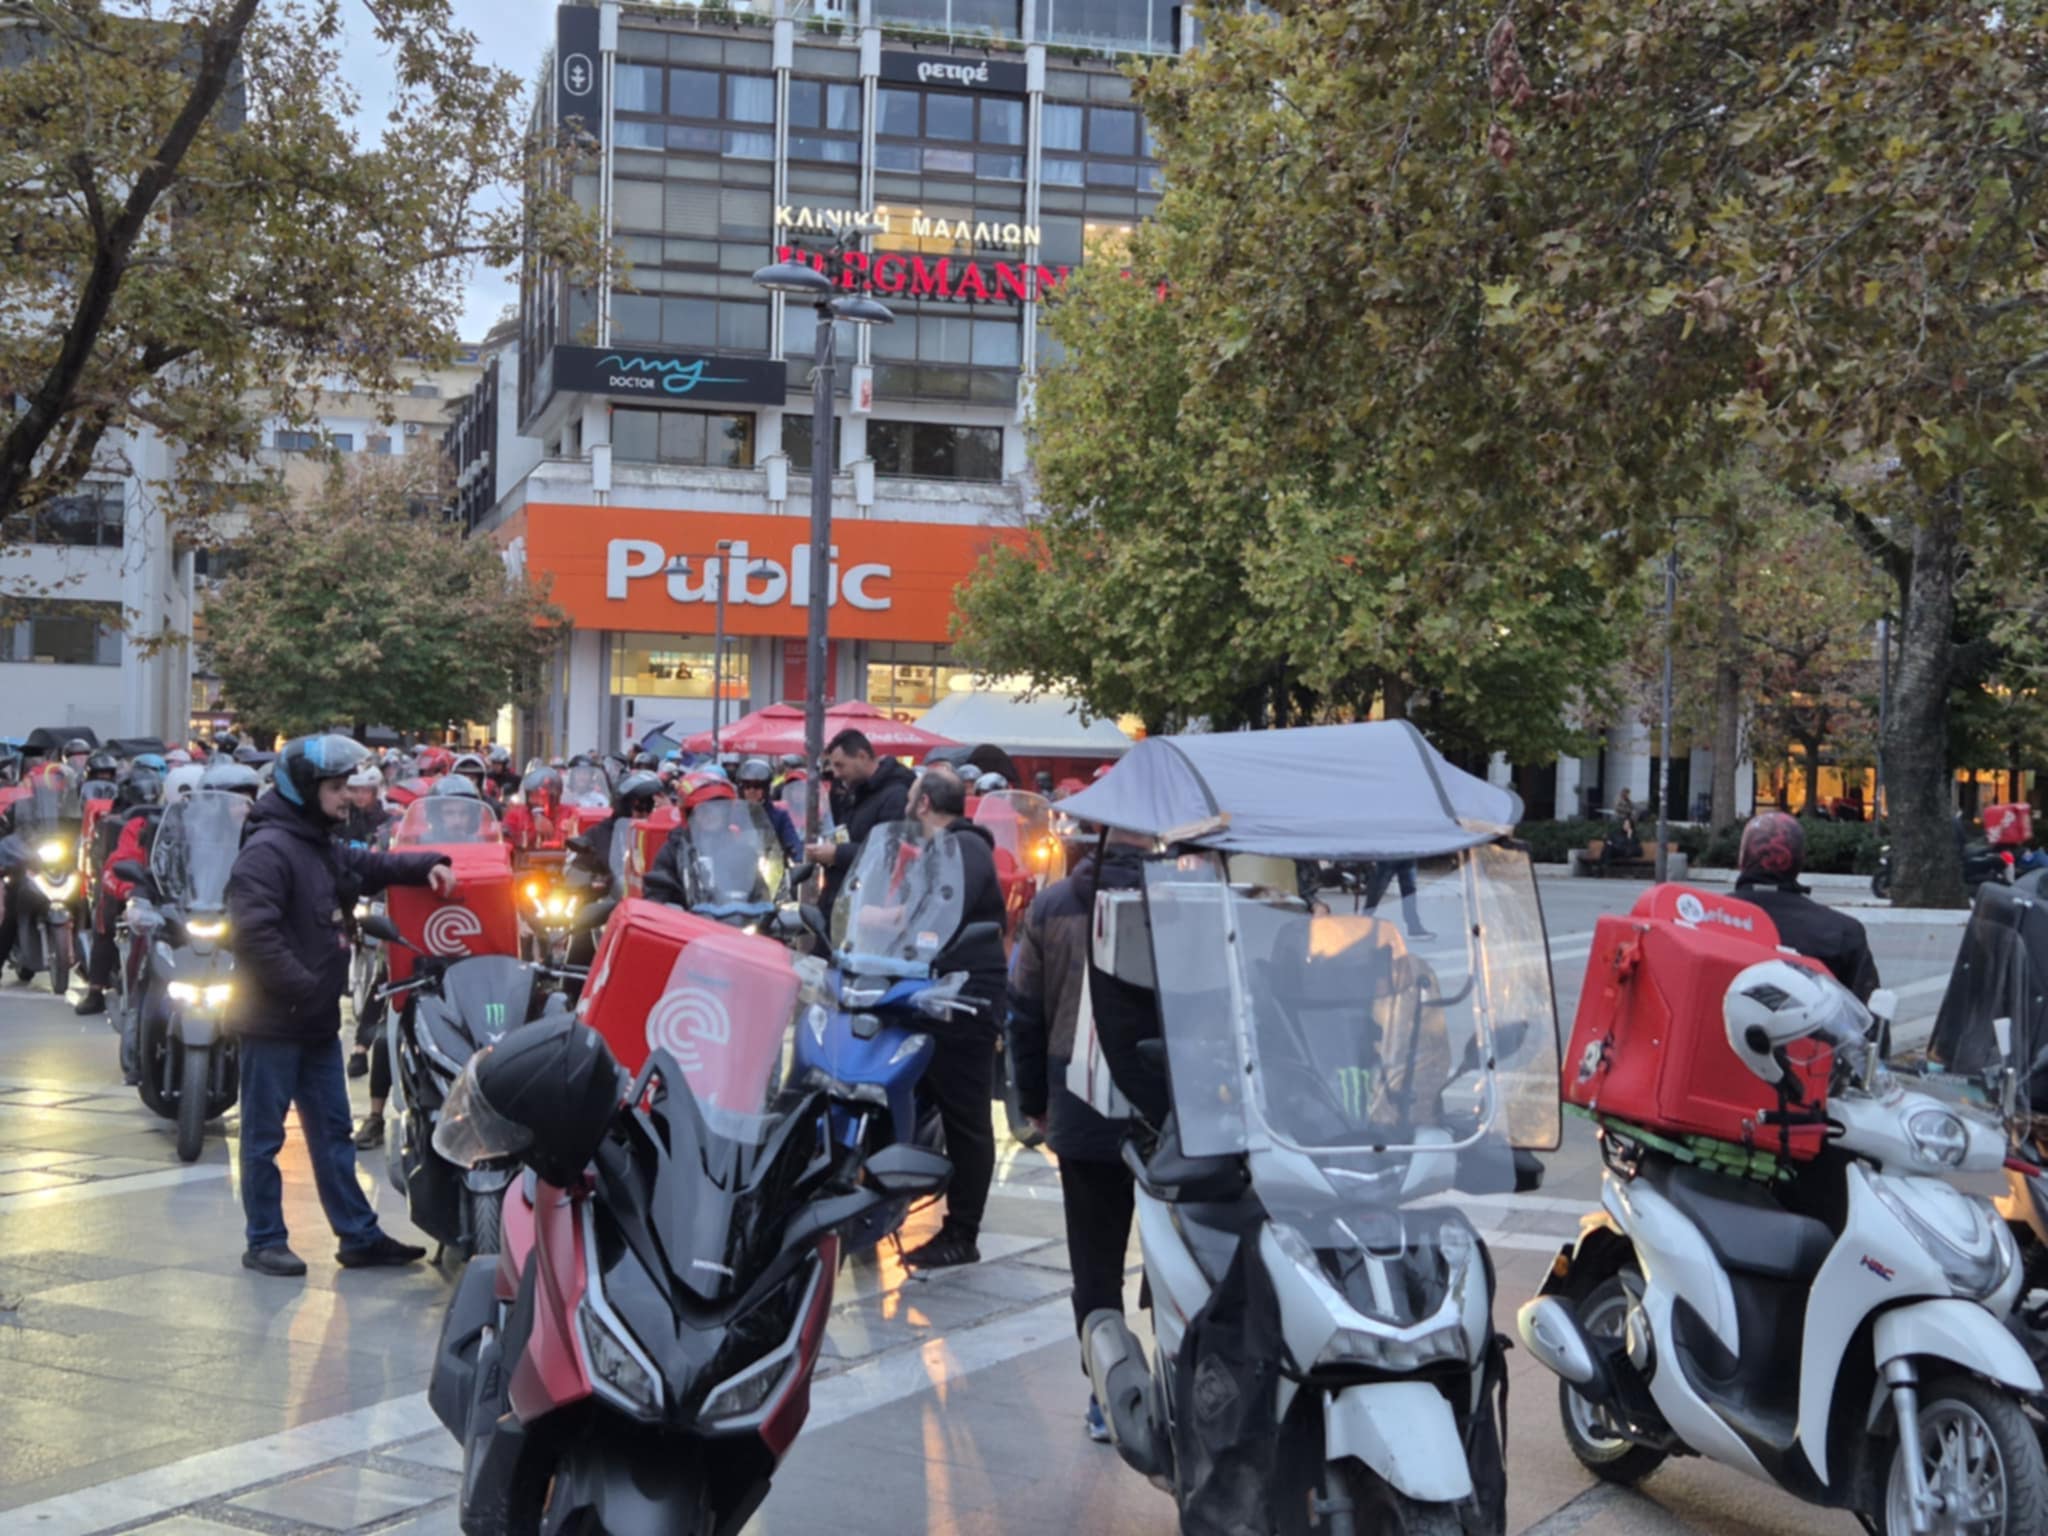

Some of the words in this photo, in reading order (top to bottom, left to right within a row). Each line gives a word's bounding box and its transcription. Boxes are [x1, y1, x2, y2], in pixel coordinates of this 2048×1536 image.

[917, 61, 989, 86] ρετιρέ
[911, 216, 1041, 245] ΜΑΛΛΙΩΝ
[609, 375, 655, 389] DOCTOR
[606, 538, 892, 611] Public
